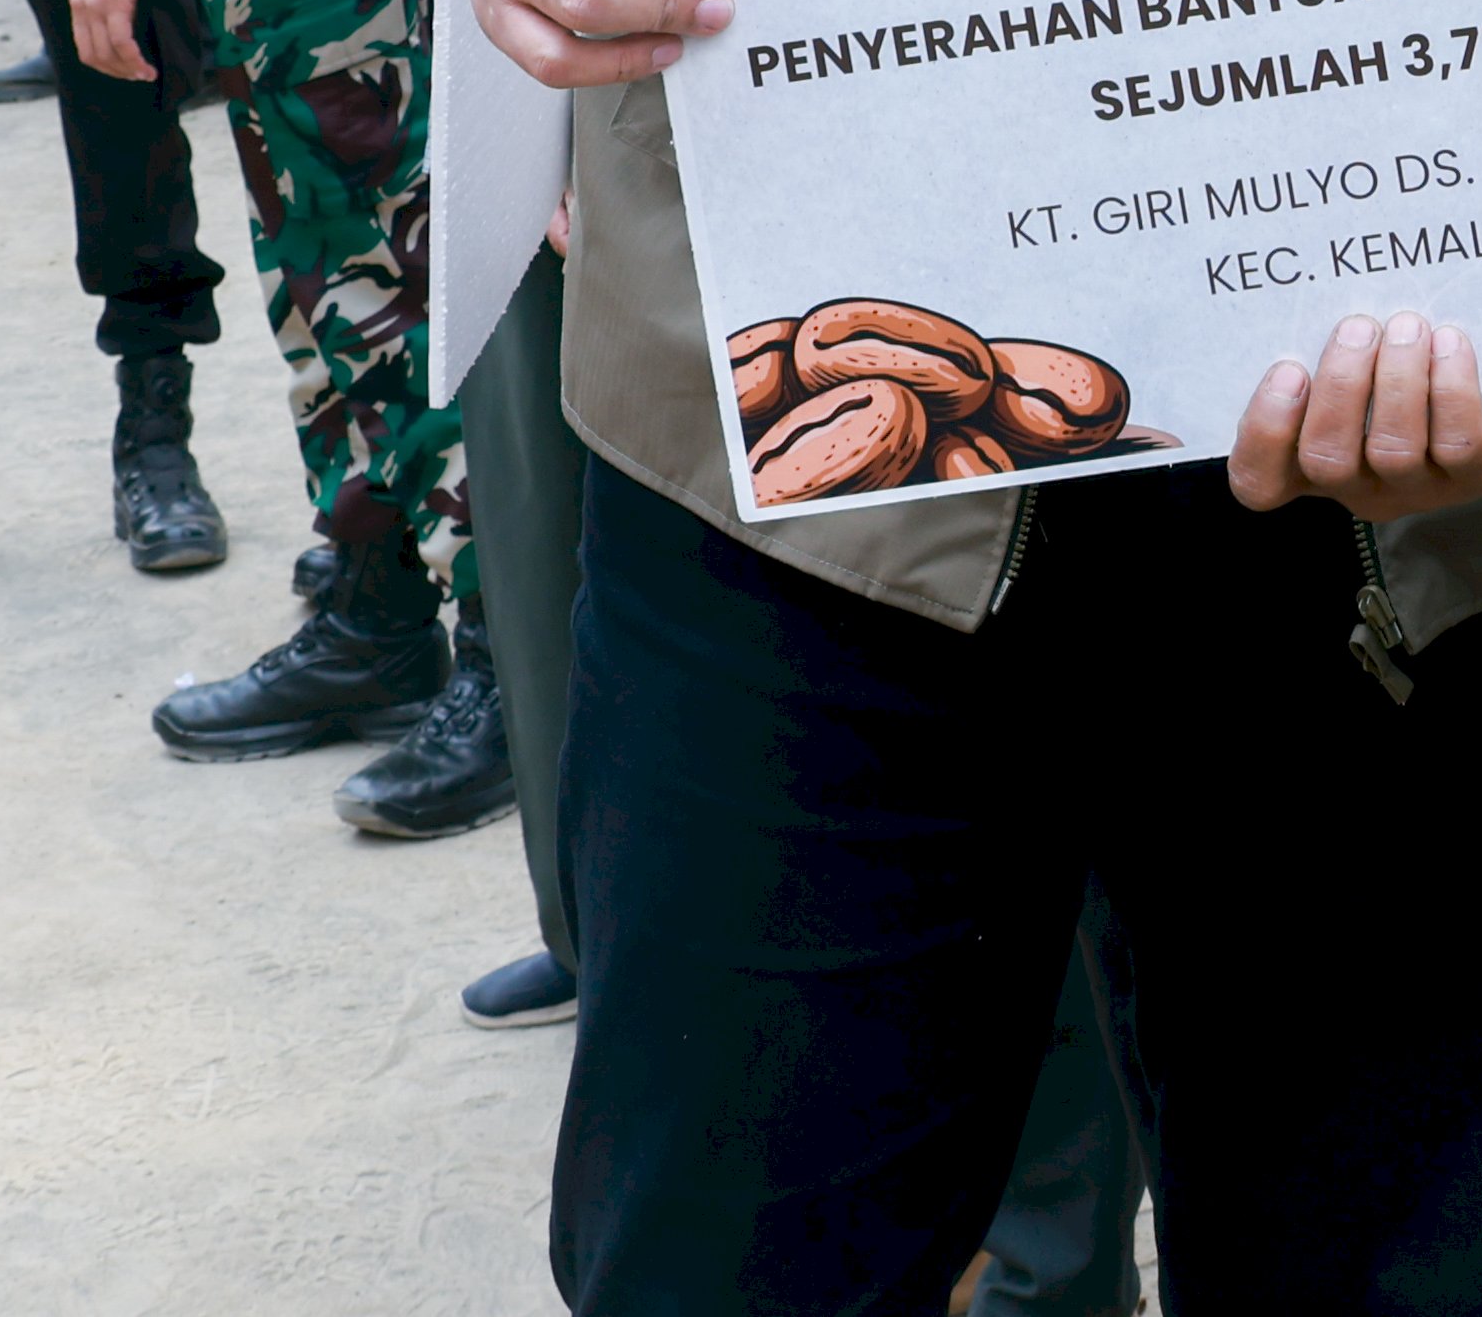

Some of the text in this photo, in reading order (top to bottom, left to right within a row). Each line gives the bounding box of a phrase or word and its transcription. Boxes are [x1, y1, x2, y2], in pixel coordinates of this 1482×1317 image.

[1090, 40, 1389, 121] SEJUMLAH
[1007, 204, 1078, 249] KT.
[1093, 187, 1189, 235] GIRI
[1204, 161, 1378, 220] MULYO
[1395, 149, 1475, 194] DS.
[1205, 246, 1314, 295] KEC.
